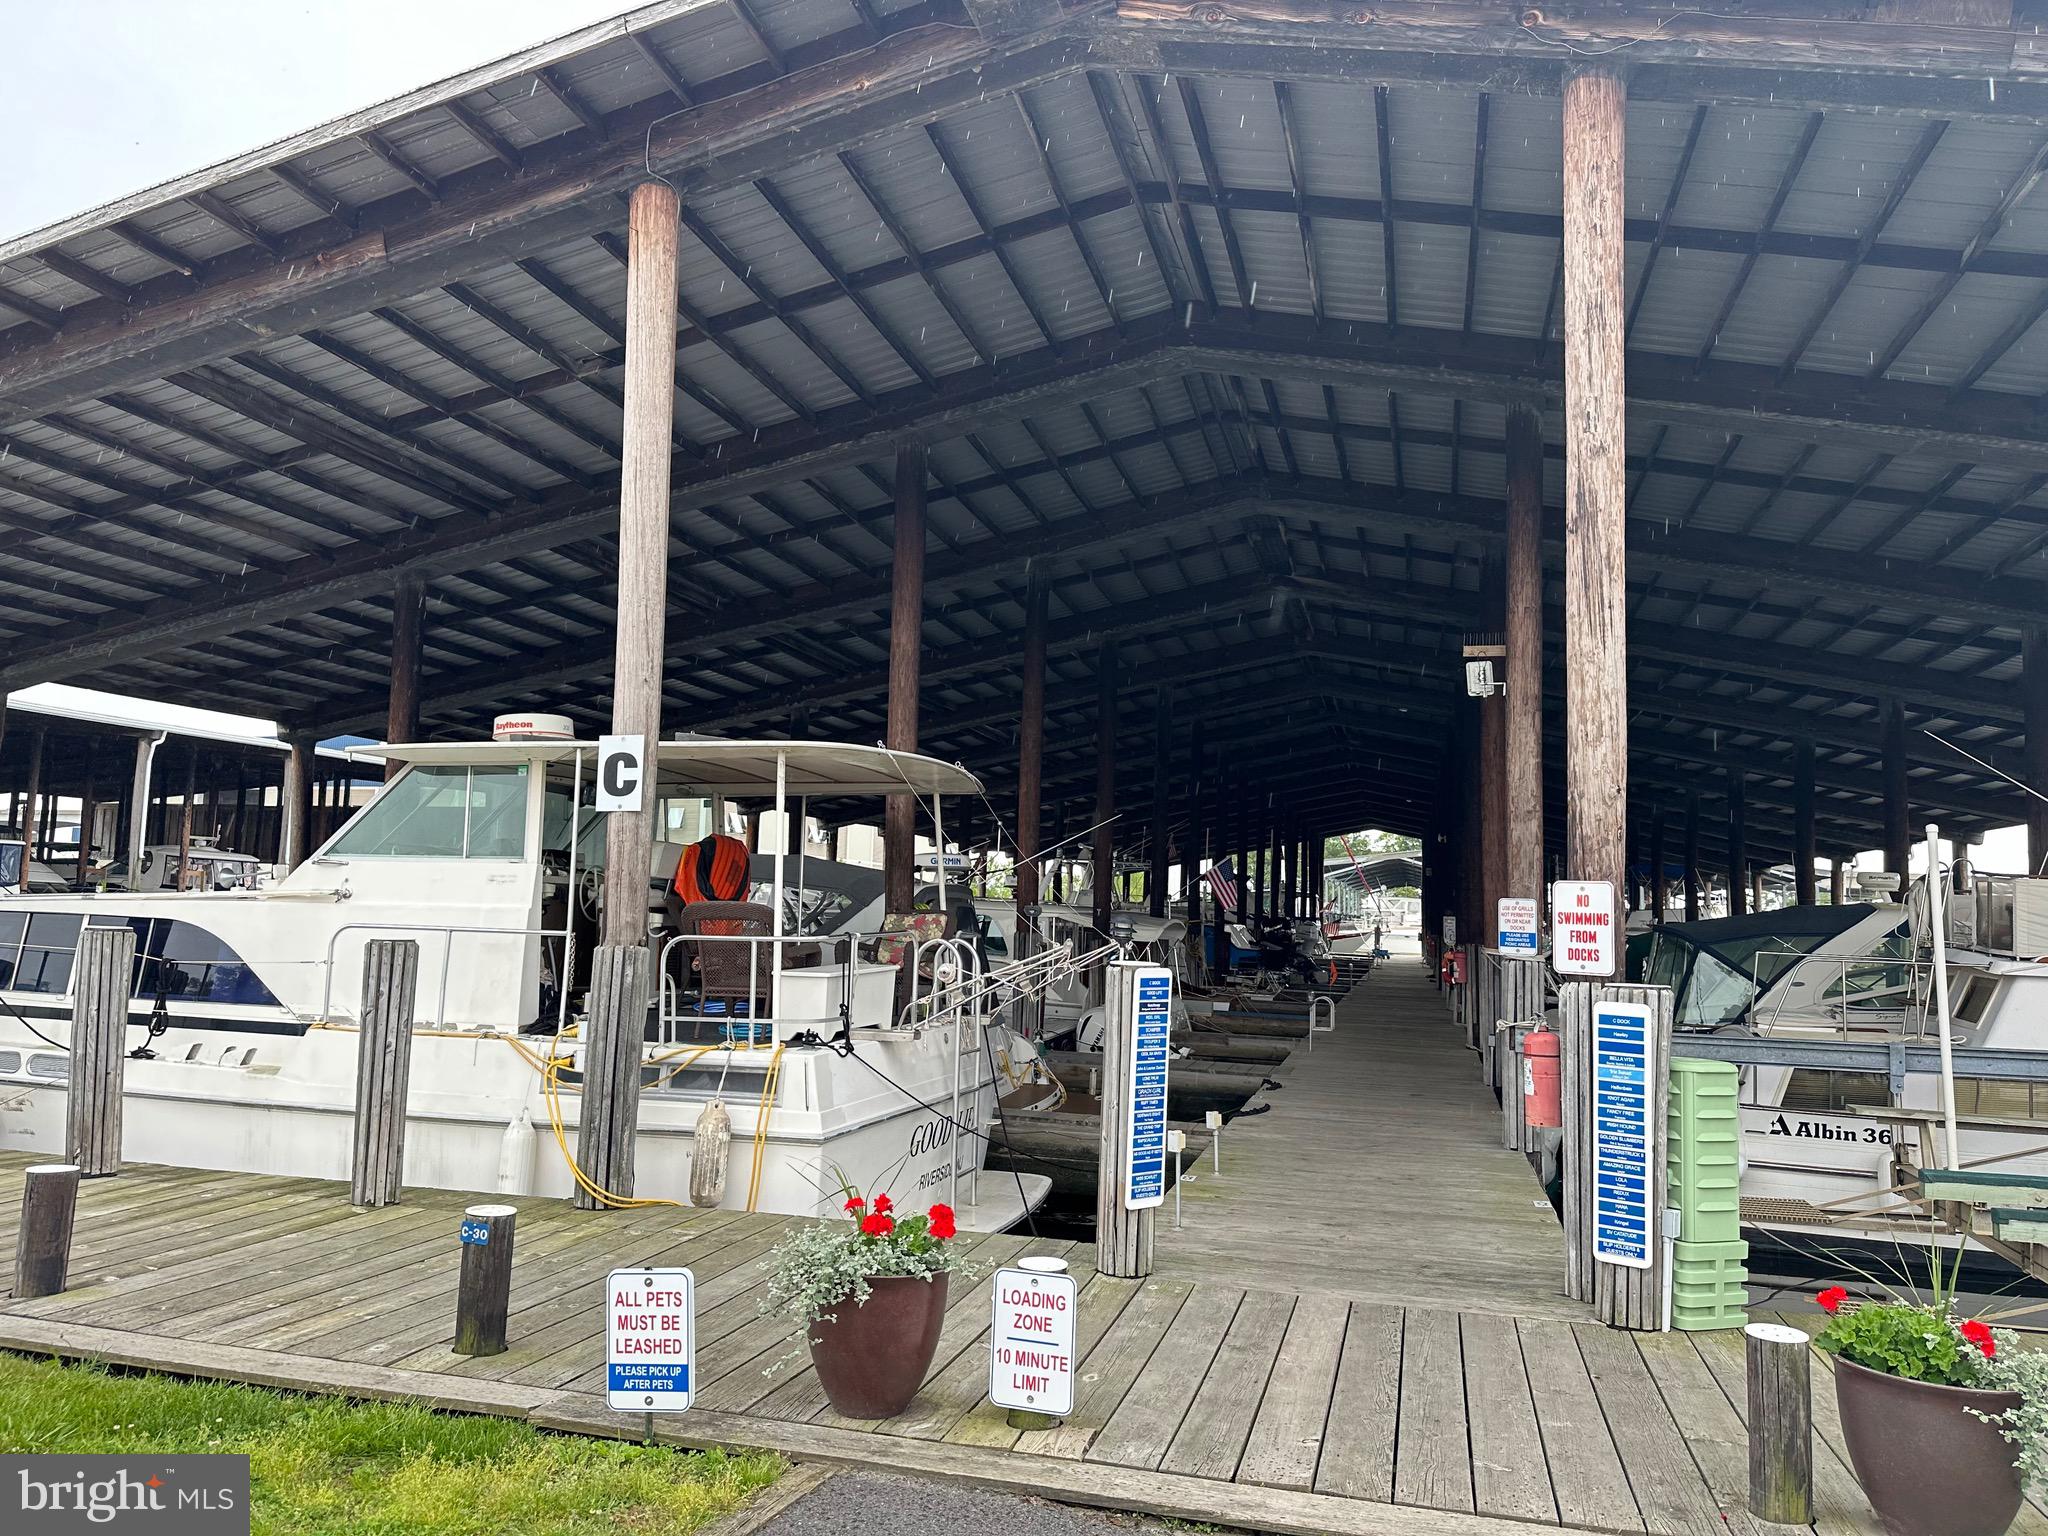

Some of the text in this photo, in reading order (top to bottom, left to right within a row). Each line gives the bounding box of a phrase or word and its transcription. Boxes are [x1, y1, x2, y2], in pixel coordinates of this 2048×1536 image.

[603, 752, 638, 797] C
[1576, 894, 1590, 907] NO
[1558, 912, 1609, 926] SWIMMING
[1570, 930, 1597, 944] FROM
[1568, 948, 1600, 962] DOCKS
[910, 1116, 952, 1157] GOOD
[1795, 1121, 1857, 1142] Albin
[1862, 1128, 1891, 1144] 36
[918, 1163, 952, 1190] RIVERSID
[462, 1226, 488, 1240] C-30
[615, 1292, 682, 1307] ALL PETS
[1003, 1288, 1066, 1311] LOADING
[618, 1315, 680, 1330] MUST BE
[1014, 1313, 1052, 1332] ZONE
[616, 1338, 682, 1354] LEASHED
[996, 1348, 1068, 1372] 10 MINUTE
[615, 1366, 682, 1376] PLEASE PICK UP
[624, 1380, 673, 1390] AFTER PETS
[1013, 1374, 1049, 1393] LIMIT
